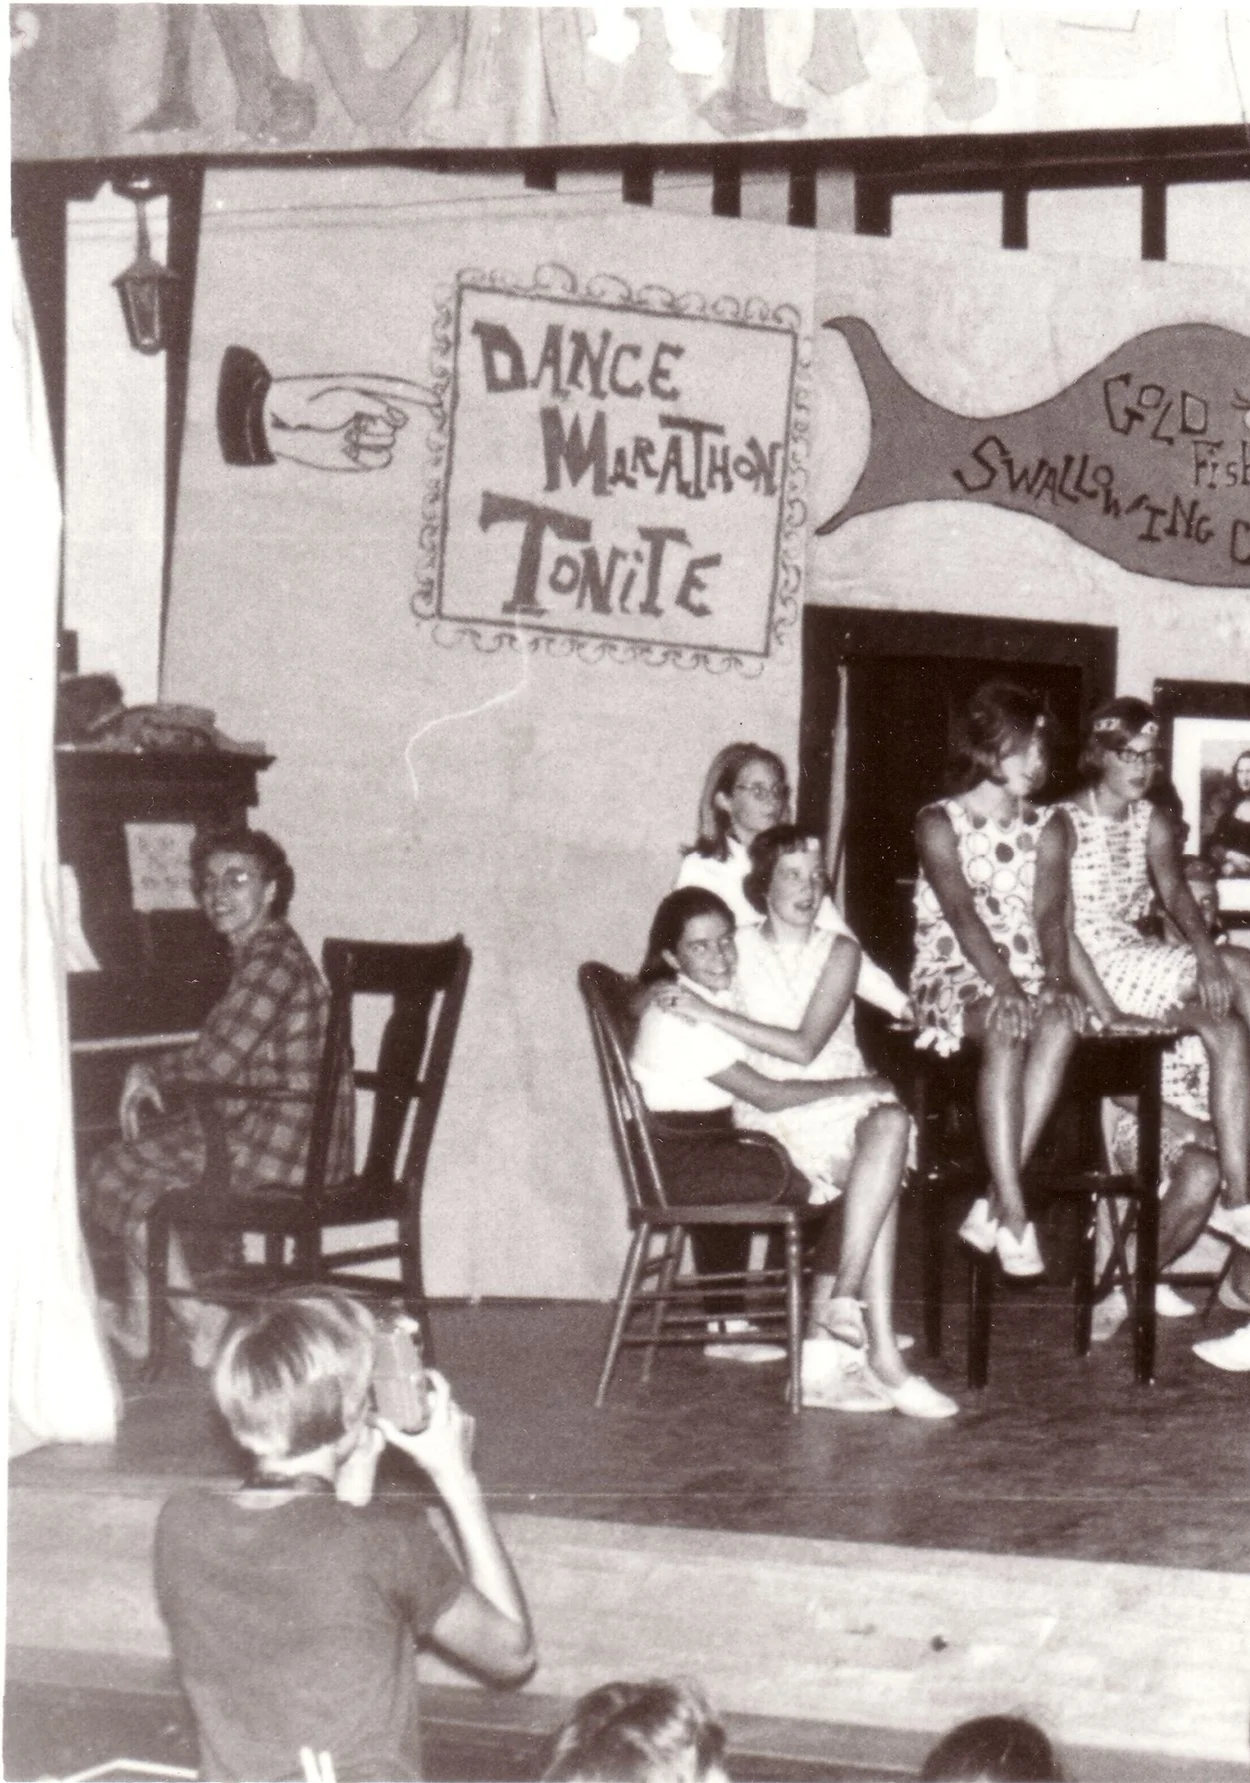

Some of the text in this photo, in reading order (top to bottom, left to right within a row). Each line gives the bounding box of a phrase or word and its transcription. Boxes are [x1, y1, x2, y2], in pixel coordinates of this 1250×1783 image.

[471, 320, 685, 400] DANCE
[540, 405, 782, 500] MARATHON
[1103, 373, 1208, 445] GOLD
[953, 435, 1215, 544] SWALLOWING
